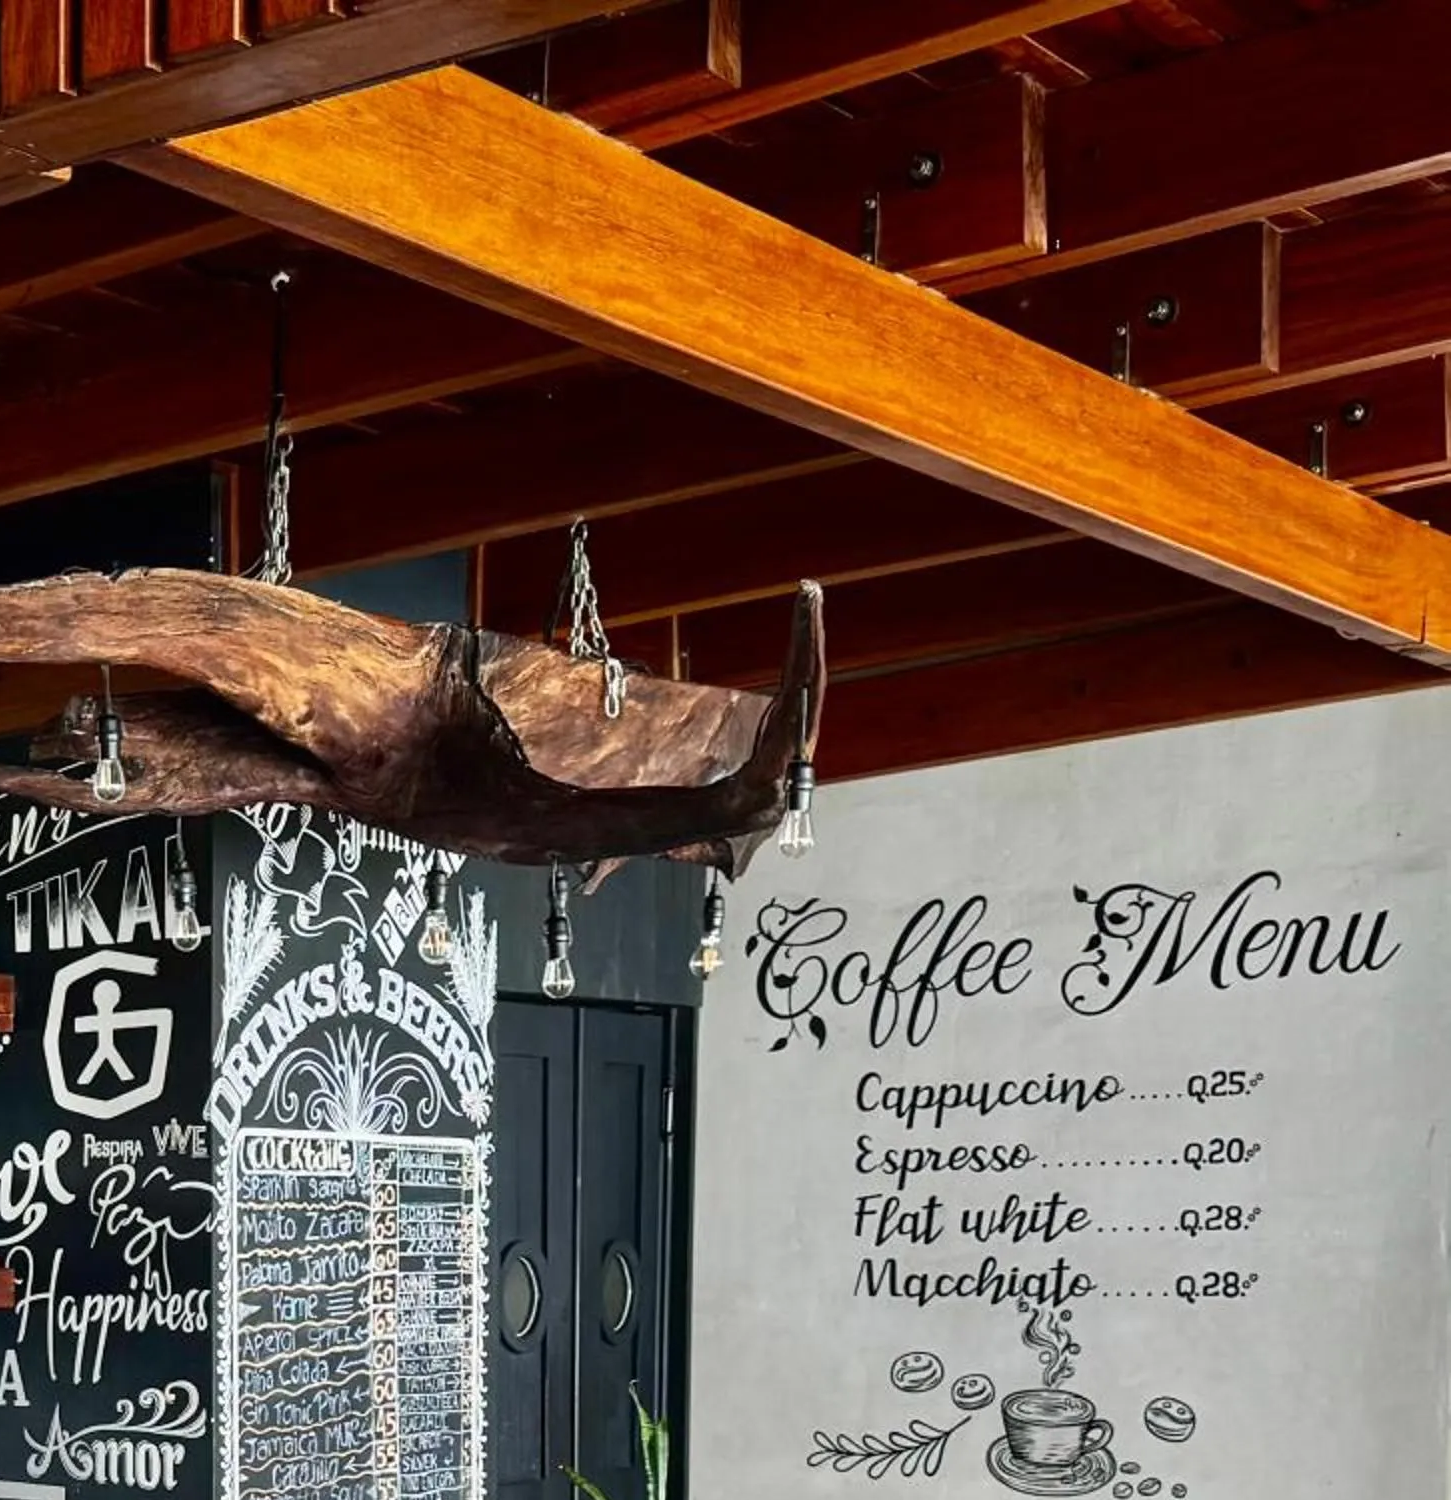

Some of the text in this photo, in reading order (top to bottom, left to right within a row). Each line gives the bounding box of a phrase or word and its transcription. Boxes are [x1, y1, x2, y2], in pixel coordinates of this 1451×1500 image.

[744, 870, 1402, 1053] Coffee Menu
[203, 955, 493, 1143] DRINKS & BEERS
[856, 1071, 1125, 1129] Cappuccino
[855, 1134, 1038, 1191] Espresso
[373, 1213, 396, 1241] 65
[854, 1194, 944, 1247] Flat
[960, 1191, 1092, 1244] white
[854, 1256, 1098, 1307] Macchiato
[5, 1245, 212, 1385] Happiness
[373, 1343, 394, 1369] 60
[374, 1376, 396, 1402] 60
[22, 1403, 186, 1491] Amor
[376, 1408, 396, 1438] 45
[376, 1446, 396, 1469] 55
